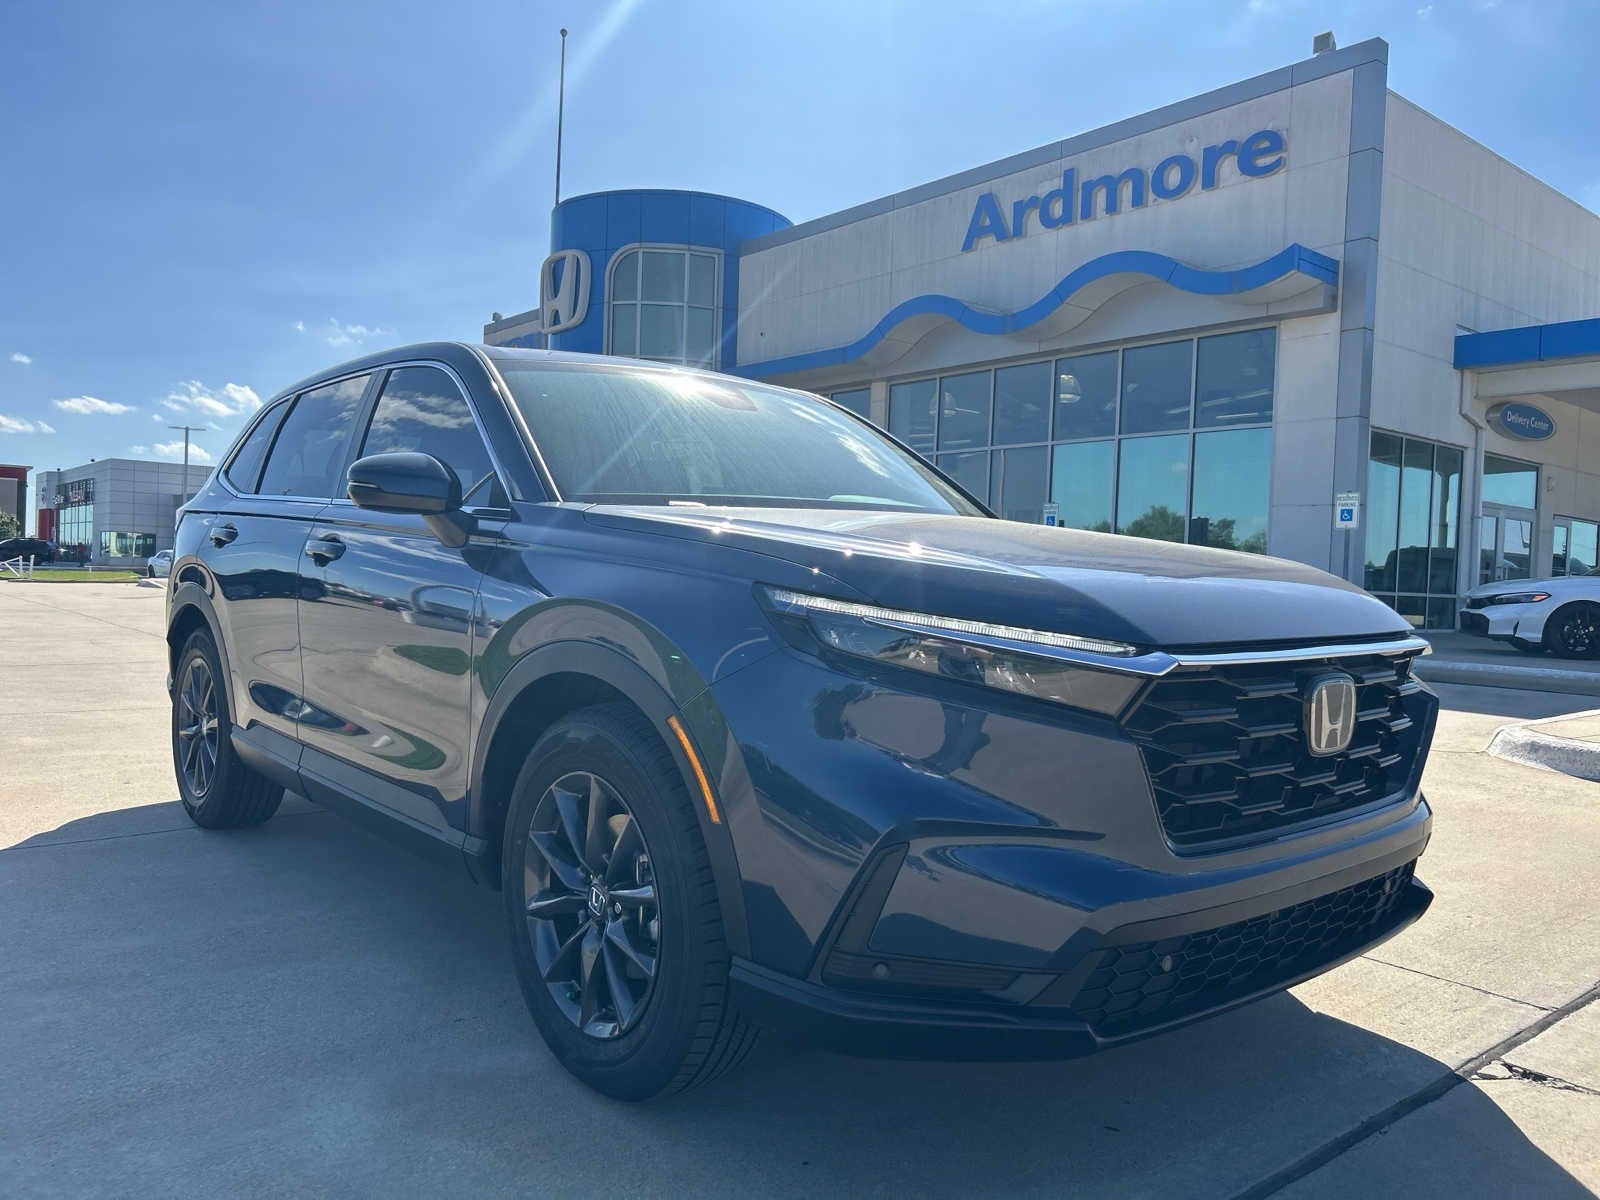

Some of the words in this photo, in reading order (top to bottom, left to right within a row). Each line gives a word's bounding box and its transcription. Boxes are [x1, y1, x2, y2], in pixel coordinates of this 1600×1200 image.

[962, 129, 1285, 253] Ardmore
[1506, 410, 1530, 429] Delivery
[1530, 416, 1549, 431] Center
